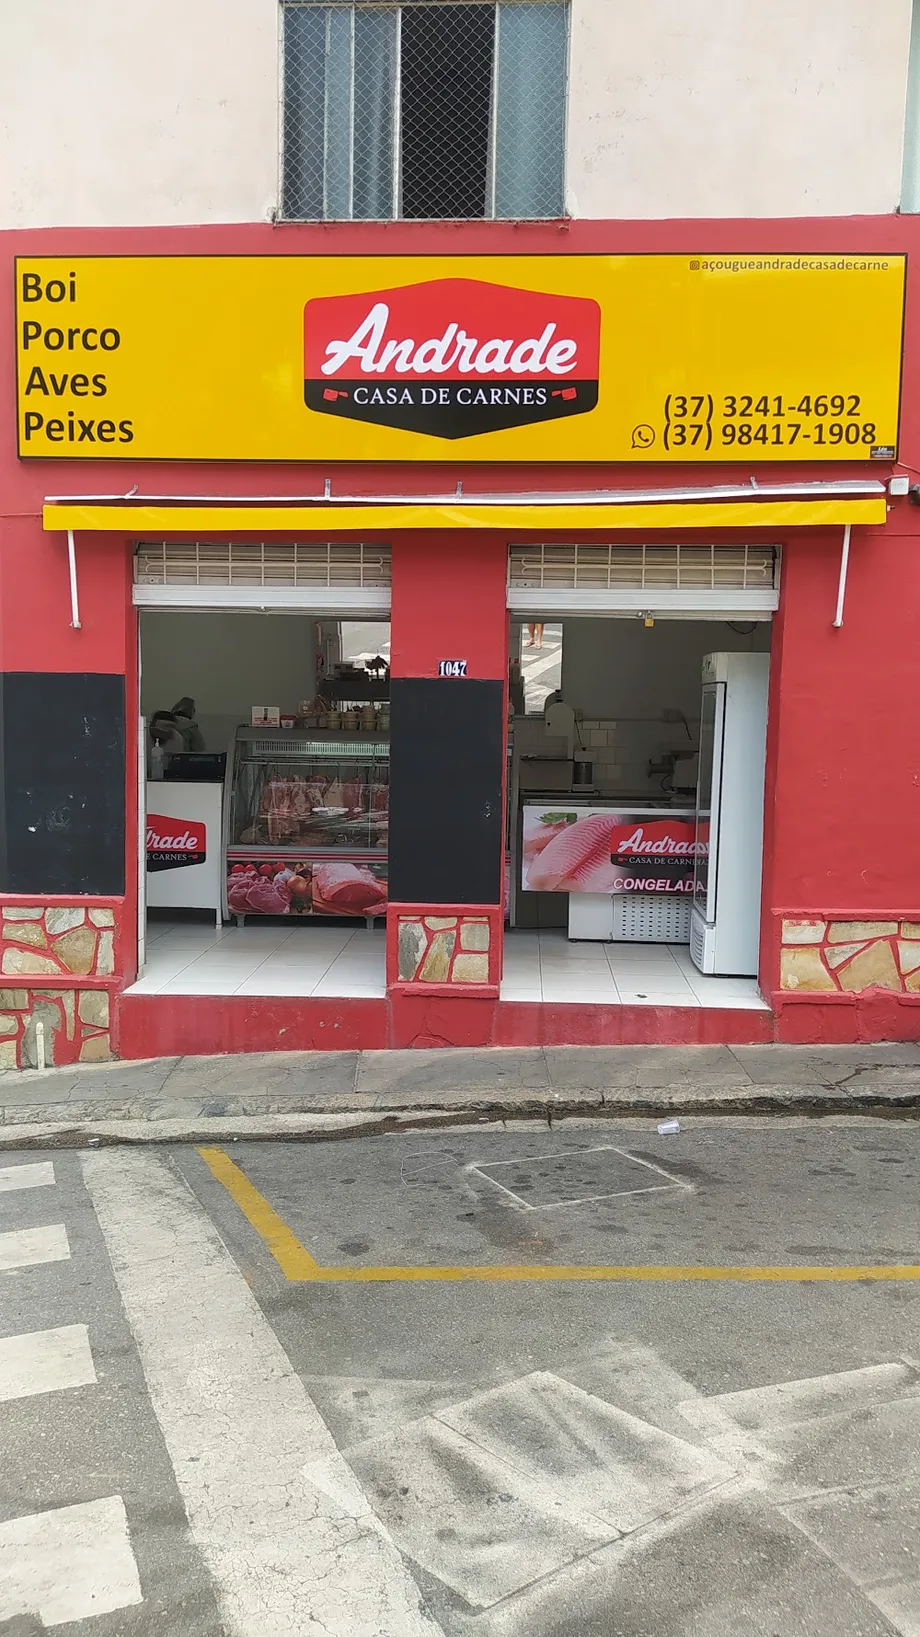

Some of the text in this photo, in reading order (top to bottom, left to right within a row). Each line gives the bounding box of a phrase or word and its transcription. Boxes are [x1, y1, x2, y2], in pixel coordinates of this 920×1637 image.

[701, 259, 889, 272] açougueandradecasadecarne
[22, 271, 77, 303] Boi
[22, 320, 121, 351] Porco
[320, 302, 578, 376] Andrade
[24, 366, 108, 397] Aves
[353, 387, 547, 405] CASA DE CARNES
[663, 394, 861, 424] (37) 3241-4692
[24, 411, 134, 443] Peixes
[662, 422, 877, 451] (37) 98417-1908
[440, 661, 467, 677] 1047
[152, 853, 187, 861] CARNES
[629, 856, 652, 865] CASA
[654, 857, 666, 865] DE
